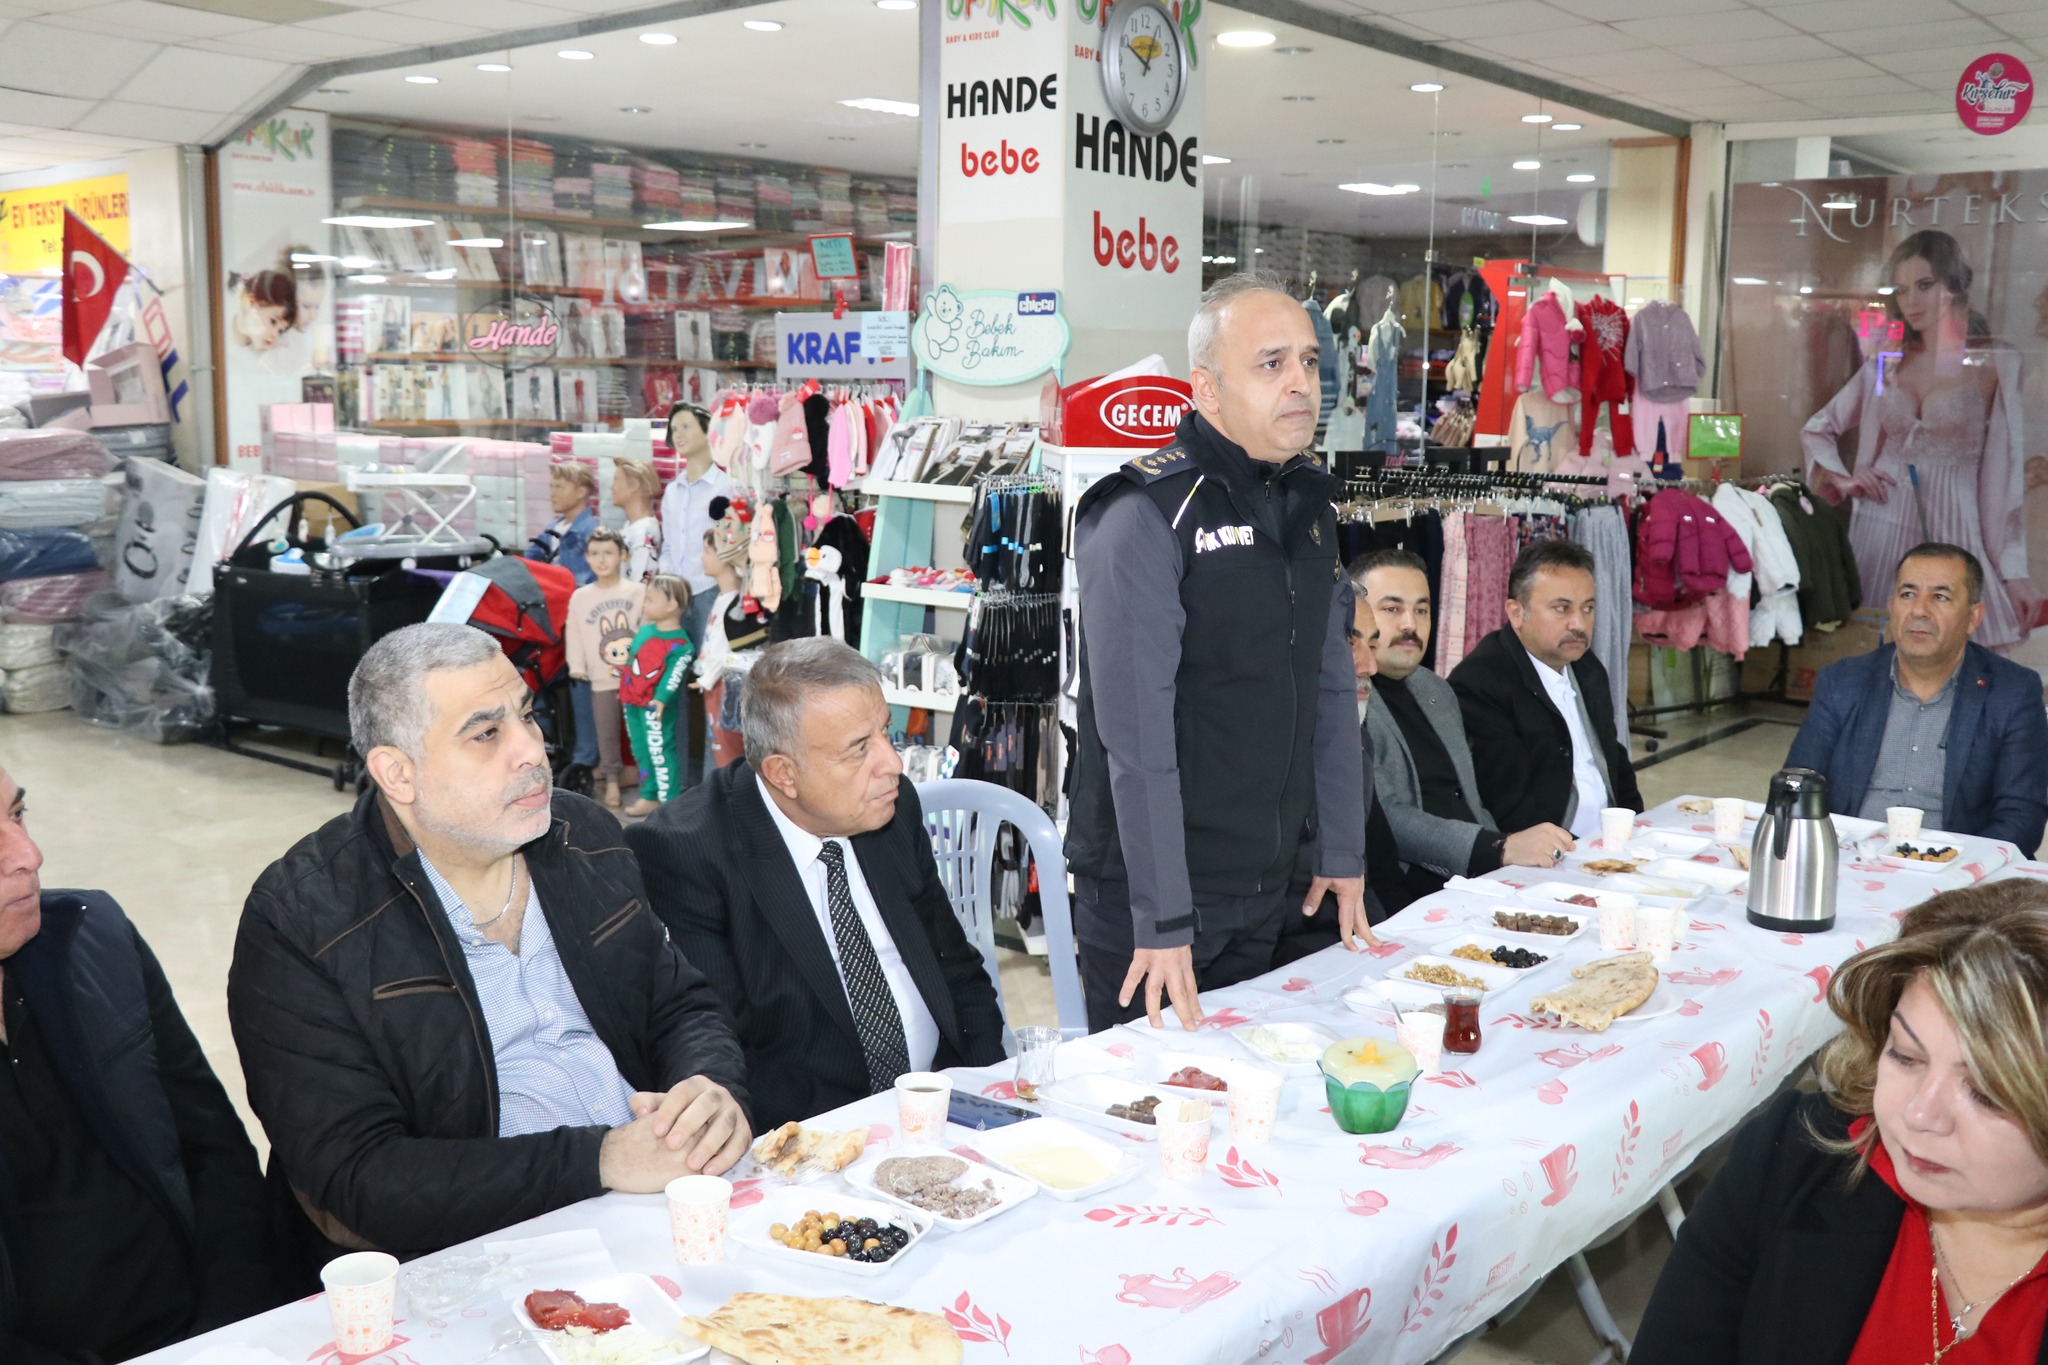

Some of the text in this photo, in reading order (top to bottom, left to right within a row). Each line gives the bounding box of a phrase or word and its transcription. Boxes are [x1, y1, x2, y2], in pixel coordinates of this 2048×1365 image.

[1131, 17, 1138, 33] 11
[1141, 13, 1151, 29] 12
[1075, 44, 1094, 60] BABY
[1164, 43, 1170, 57] 2
[1167, 63, 1174, 78] 3
[947, 73, 1057, 119] HANDE
[1155, 98, 1161, 112] 5
[1142, 103, 1149, 118] 6
[961, 139, 1040, 178] bebe
[1075, 112, 1198, 188] HANDE
[12, 204, 26, 229] EV
[1093, 210, 1180, 273] bebe
[1019, 295, 1055, 313] chicco
[469, 315, 559, 352] Hande
[966, 309, 1017, 339] Bebek
[787, 331, 875, 365] KRAF
[962, 334, 1025, 370] Bakım
[1111, 404, 1182, 427] GECEM
